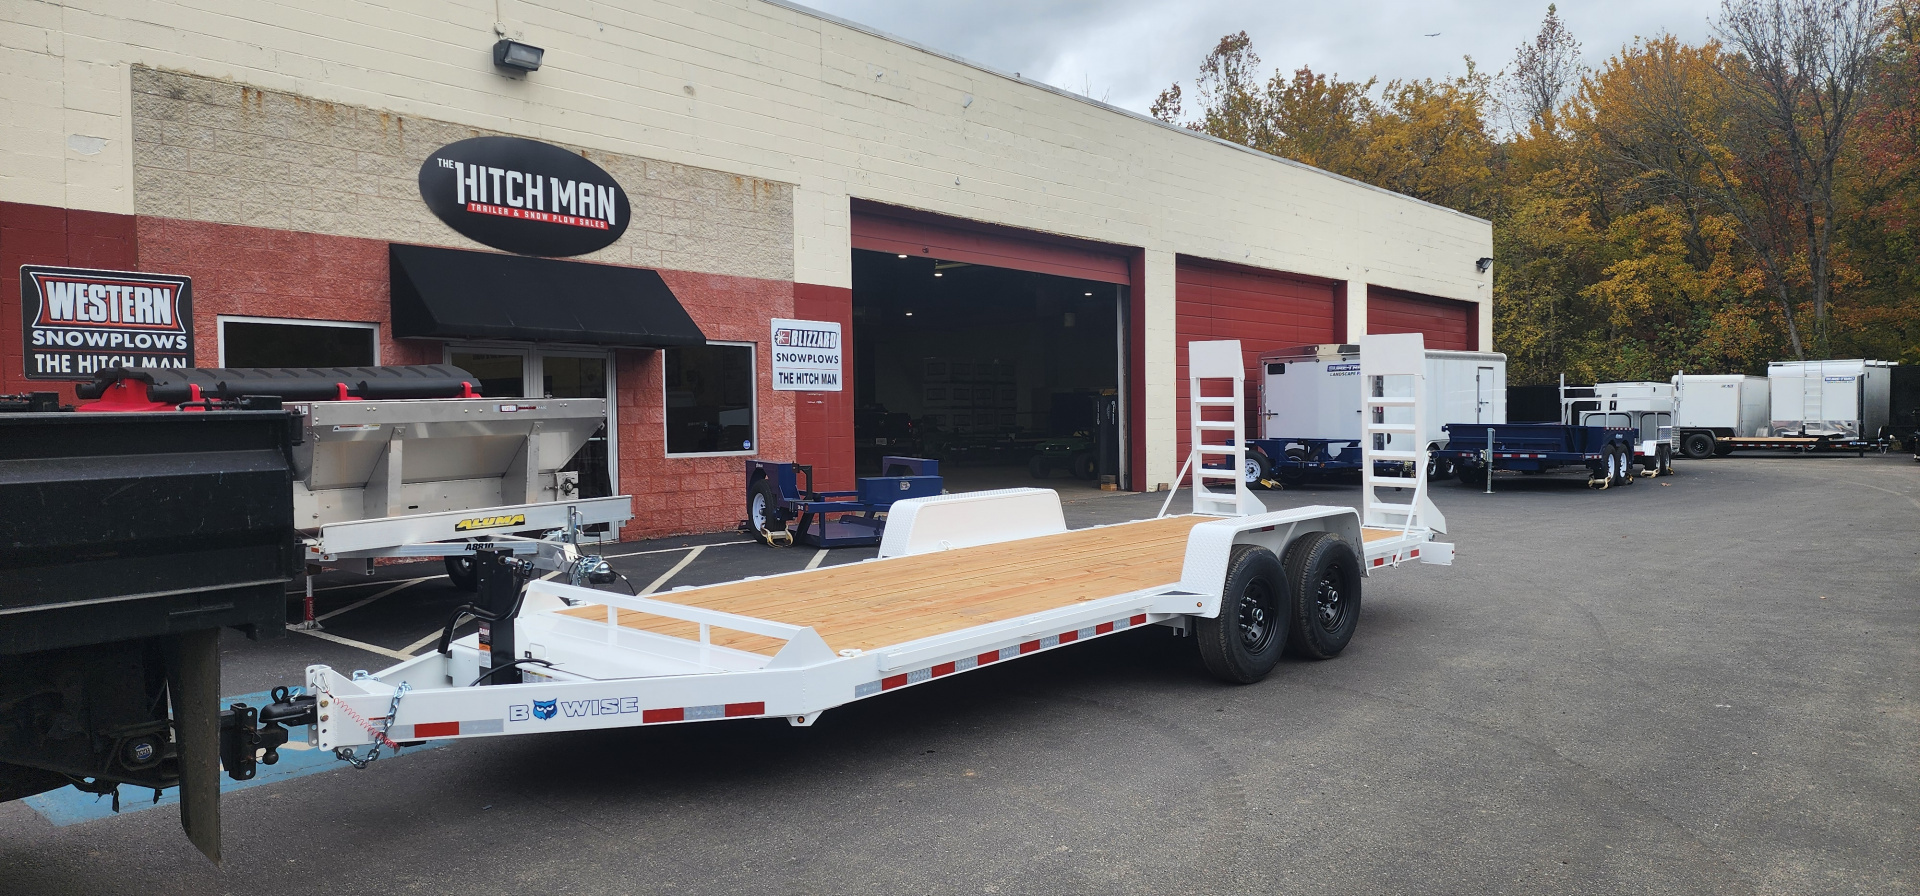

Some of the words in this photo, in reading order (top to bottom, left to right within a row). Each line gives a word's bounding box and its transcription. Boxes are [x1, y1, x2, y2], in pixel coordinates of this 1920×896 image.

[437, 158, 455, 169] THE
[454, 162, 545, 211] HITCH
[550, 177, 616, 225] MAN
[470, 203, 509, 216] TRAILER
[513, 209, 520, 218] &
[524, 210, 549, 221] SNOW
[552, 214, 575, 224] PLOW
[579, 218, 606, 228] SALES
[45, 281, 172, 325] WESTERN
[32, 330, 188, 350] SNOWPLOWS
[790, 330, 837, 349] BLIZZARD
[34, 353, 72, 373] THE
[77, 354, 135, 374] HITCH
[141, 356, 187, 369] MAN
[776, 352, 839, 364] SNOWPLOWS
[779, 372, 794, 384] THE
[796, 372, 819, 385] HITCH
[821, 373, 837, 385] MAN
[456, 514, 525, 529] ALUMA
